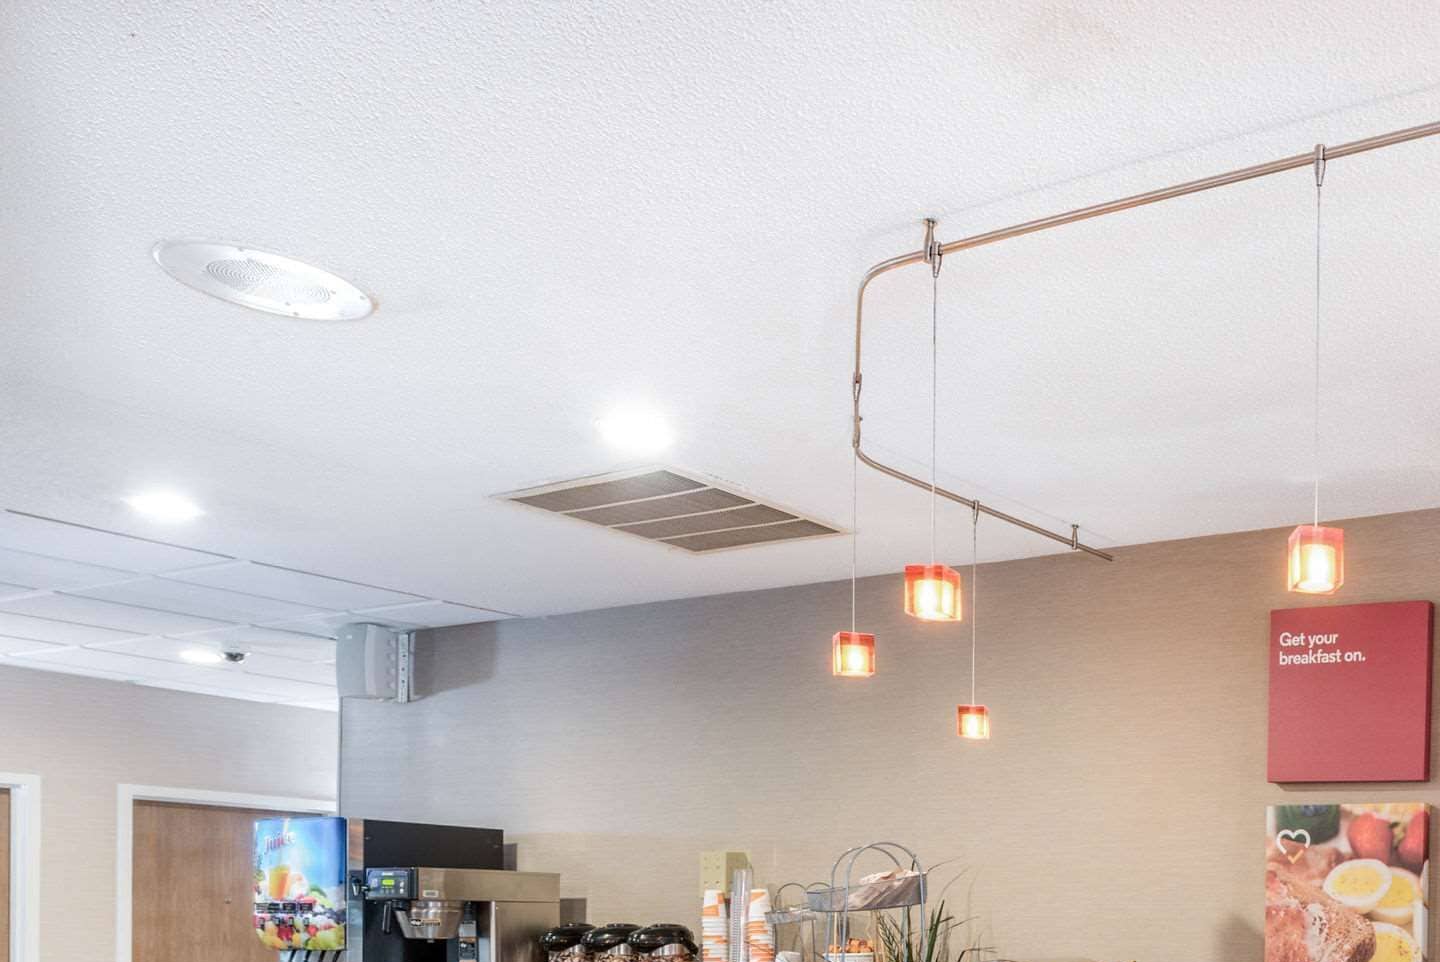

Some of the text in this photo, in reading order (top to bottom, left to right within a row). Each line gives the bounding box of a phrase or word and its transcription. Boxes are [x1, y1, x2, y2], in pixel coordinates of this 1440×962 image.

[1279, 632, 1338, 648] Get your
[1279, 649, 1366, 665] breakfast on.
